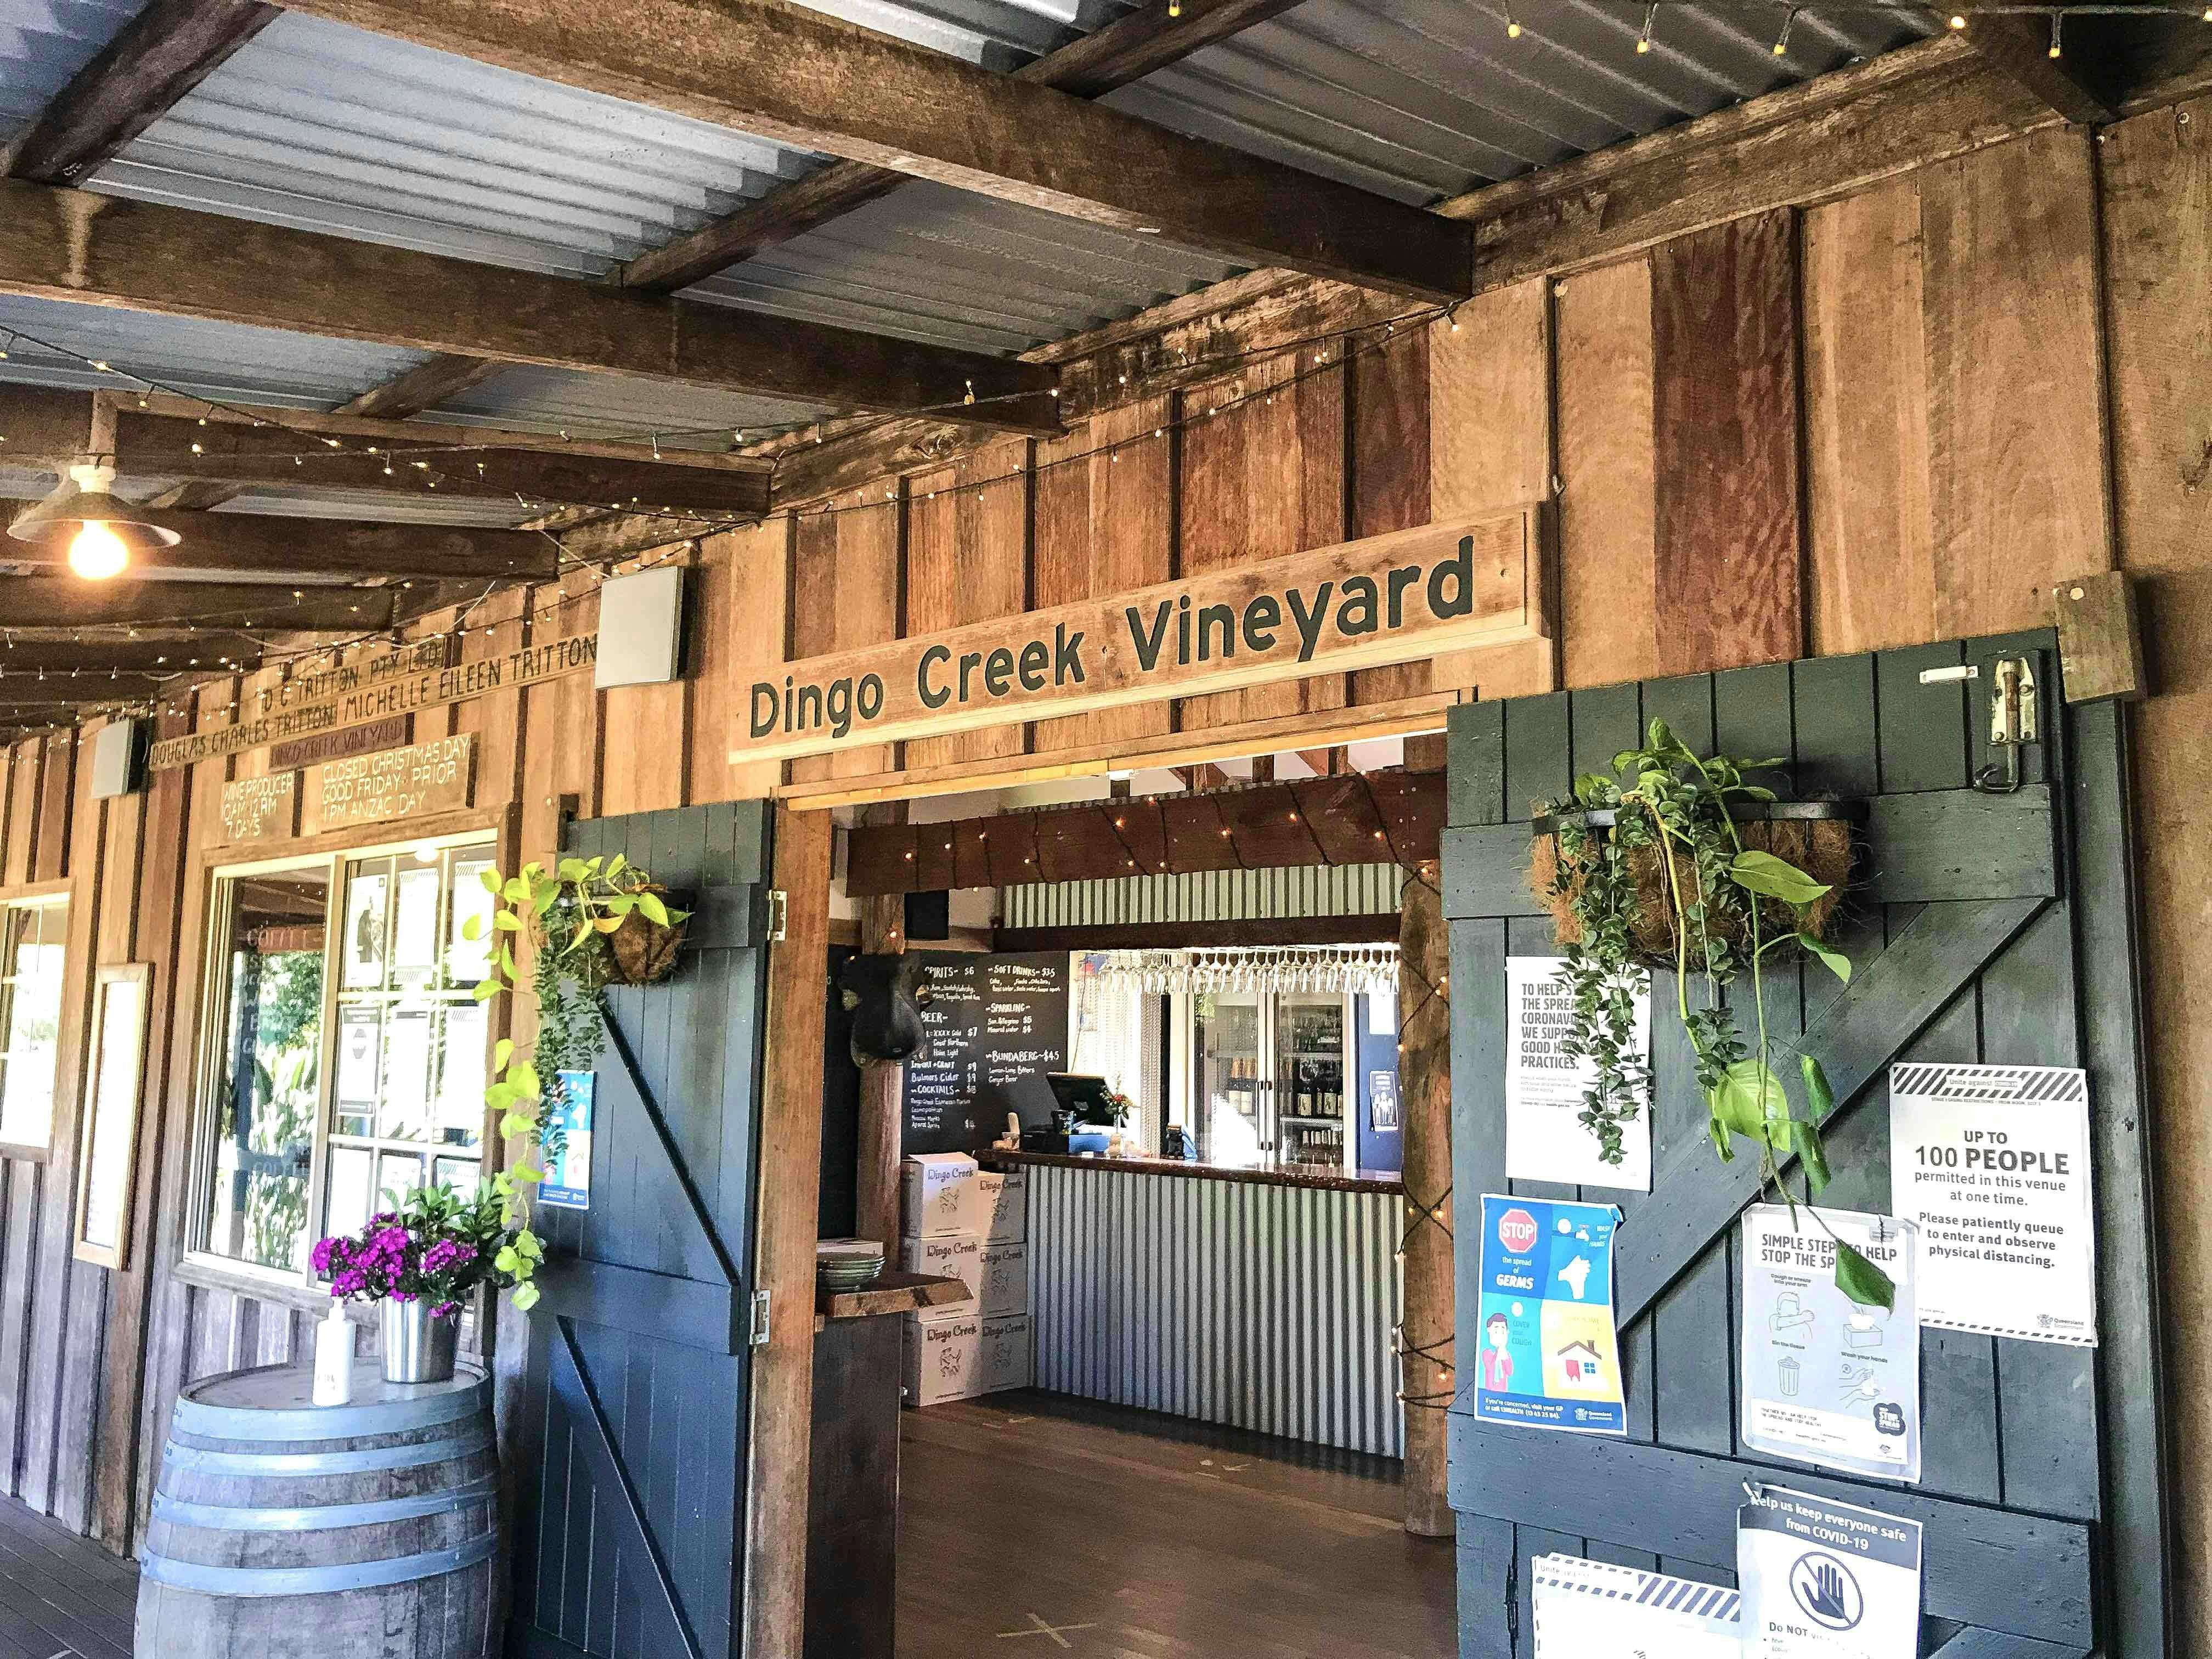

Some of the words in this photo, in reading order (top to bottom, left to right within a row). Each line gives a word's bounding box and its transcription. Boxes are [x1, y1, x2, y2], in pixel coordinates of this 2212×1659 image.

[751, 676, 883, 738] Dingo
[918, 623, 1084, 708] Creek
[1126, 535, 1474, 671] Vineyard
[212, 719, 268, 753] CHARLES
[345, 676, 430, 722] MICHELLE
[439, 658, 500, 699] EILEEN
[509, 633, 597, 681] TRITTON
[323, 757, 368, 785] CLOSED
[371, 742, 441, 775] CHRISTMAS
[443, 736, 470, 761] DAY
[322, 781, 353, 805] GOOD
[412, 760, 457, 786] PRIOR
[351, 796, 392, 818] ANZAC
[398, 790, 426, 815] DAY
[994, 964, 1011, 974] SOFT
[1012, 966, 1036, 977] DRINKS
[1521, 983, 1534, 996] TO
[1537, 983, 1562, 996] HELP
[990, 1003, 1026, 1013] SPARKLING
[1521, 998, 1541, 1010] THE
[1544, 998, 1576, 1011] SPREA
[921, 1011, 943, 1023] BEER
[1521, 1012, 1573, 1025] CORONAV
[1521, 1026, 1538, 1039] WE
[1521, 1041, 1550, 1054] GOOD
[991, 1050, 1039, 1063] BUNDABERG
[1521, 1055, 1579, 1070] PRACTICES.
[917, 1085, 954, 1095] COCKTAILS
[1964, 1130, 1983, 1143] UP
[1987, 1132, 2008, 1144] TO
[1915, 1146, 1958, 1167] 100
[1966, 1148, 2070, 1175] PEOPLE
[928, 1169, 950, 1182] Dingo
[952, 1167, 974, 1178] Creek
[1915, 1171, 1975, 1186] permitted
[1979, 1175, 1991, 1186] in
[1996, 1176, 2022, 1189] this
[2025, 1180, 2066, 1192] venue
[980, 1180, 1001, 1193] Dingo
[1950, 1190, 1962, 1201] at
[1966, 1193, 1990, 1204] one
[1993, 1193, 2028, 1206] time.
[1502, 1222, 1534, 1240] STOP
[1919, 1211, 1959, 1225] Please
[1962, 1216, 2021, 1232] patiently
[2024, 1223, 2064, 1235] queue
[1762, 1234, 1803, 1250] SIMPLE
[1808, 1239, 1836, 1254] STEP
[1866, 1246, 1897, 1261] HELP
[1927, 1228, 1939, 1239] to
[1943, 1232, 1974, 1243] enter
[1978, 1233, 2001, 1245] and
[2005, 1236, 2056, 1251] observe
[926, 1245, 952, 1260] Dingo
[1762, 1249, 1791, 1263] STOP
[1795, 1253, 1816, 1267] THE
[1929, 1244, 1980, 1260] physical
[1983, 1250, 2056, 1269] distancing.
[1502, 1256, 1512, 1264] the
[1513, 1257, 1532, 1266] spread
[1496, 1273, 1534, 1290] GERMS
[927, 1329, 952, 1343] Dingo
[953, 1323, 977, 1337] Creek
[1780, 1502, 1793, 1513] us
[1795, 1503, 1822, 1522] keep
[1825, 1513, 1878, 1535] everyone
[1880, 1526, 1907, 1542] safe
[1786, 1517, 1810, 1534] from
[1813, 1526, 1869, 1550] COVID-19
[1769, 1622, 1783, 1632] Do
[1786, 1624, 1808, 1637] NOT
